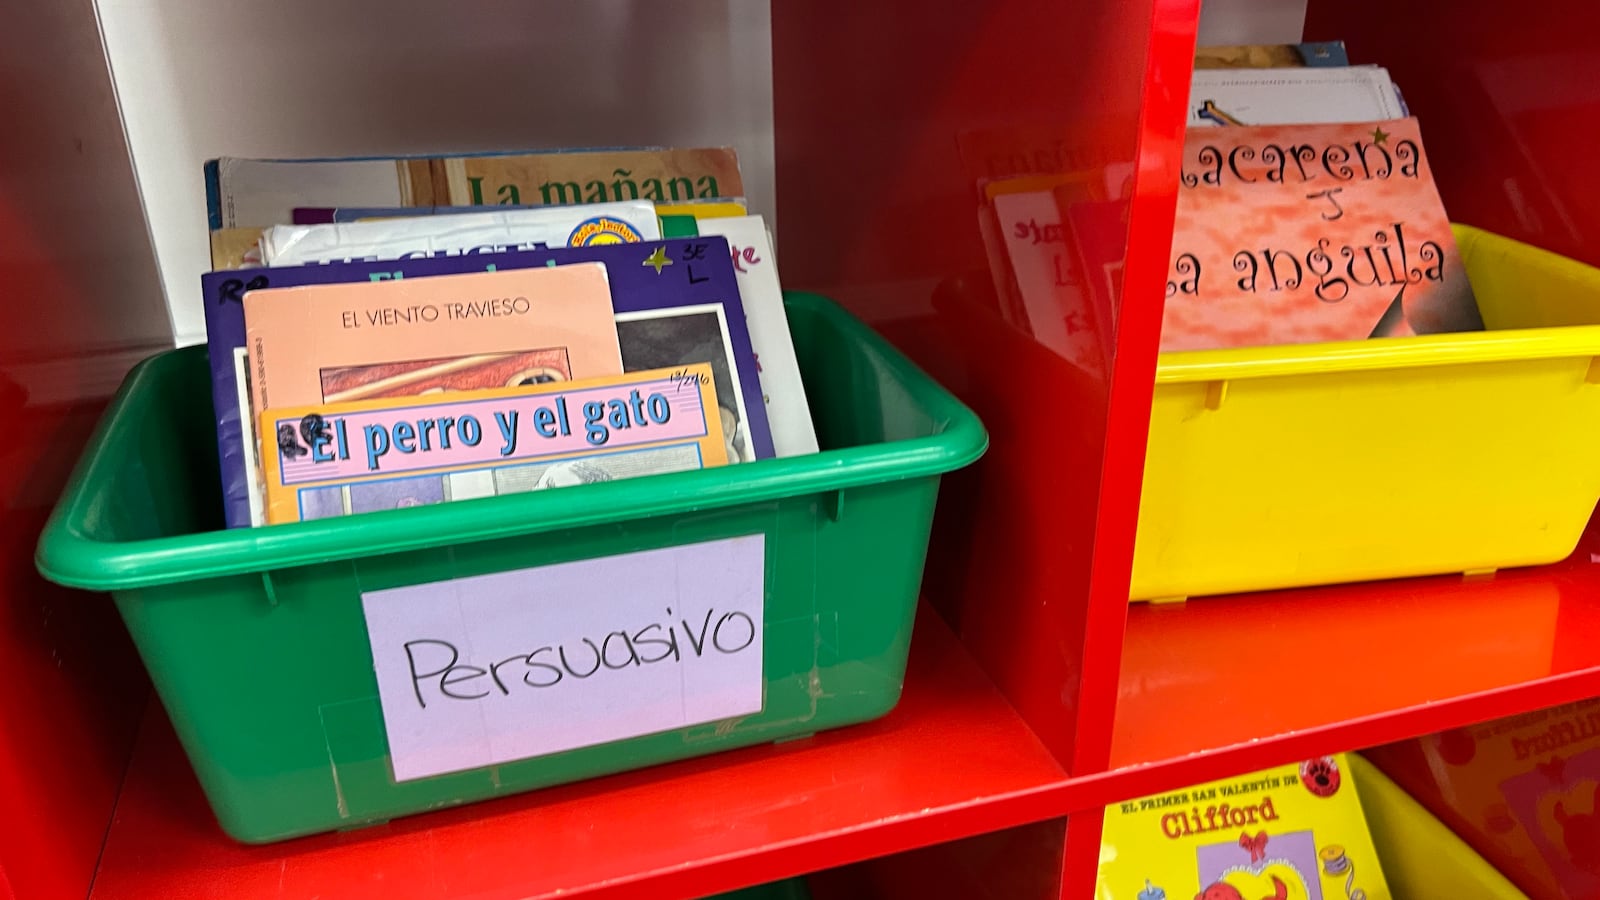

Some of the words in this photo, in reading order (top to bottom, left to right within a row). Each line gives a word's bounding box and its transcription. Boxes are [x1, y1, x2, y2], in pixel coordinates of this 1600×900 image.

[467, 175, 521, 206] La
[538, 168, 720, 204] mañana
[687, 264, 709, 285] L
[1232, 221, 1445, 305] anguila
[342, 310, 361, 329] EL
[366, 304, 439, 328] VIENTO
[443, 296, 531, 321] TRAVIESO
[311, 416, 350, 464] El
[362, 412, 483, 471] perro
[493, 407, 520, 456] y
[532, 394, 571, 439] el
[582, 389, 672, 446] gato
[403, 607, 756, 710] Persuasivo
[1120, 802, 1138, 815] EL
[1140, 793, 1190, 812] PRIMER
[1192, 788, 1217, 803] SAN
[1220, 776, 1281, 798] VALENTÍN
[1283, 774, 1299, 787] DE
[1160, 797, 1280, 840] Clifford
